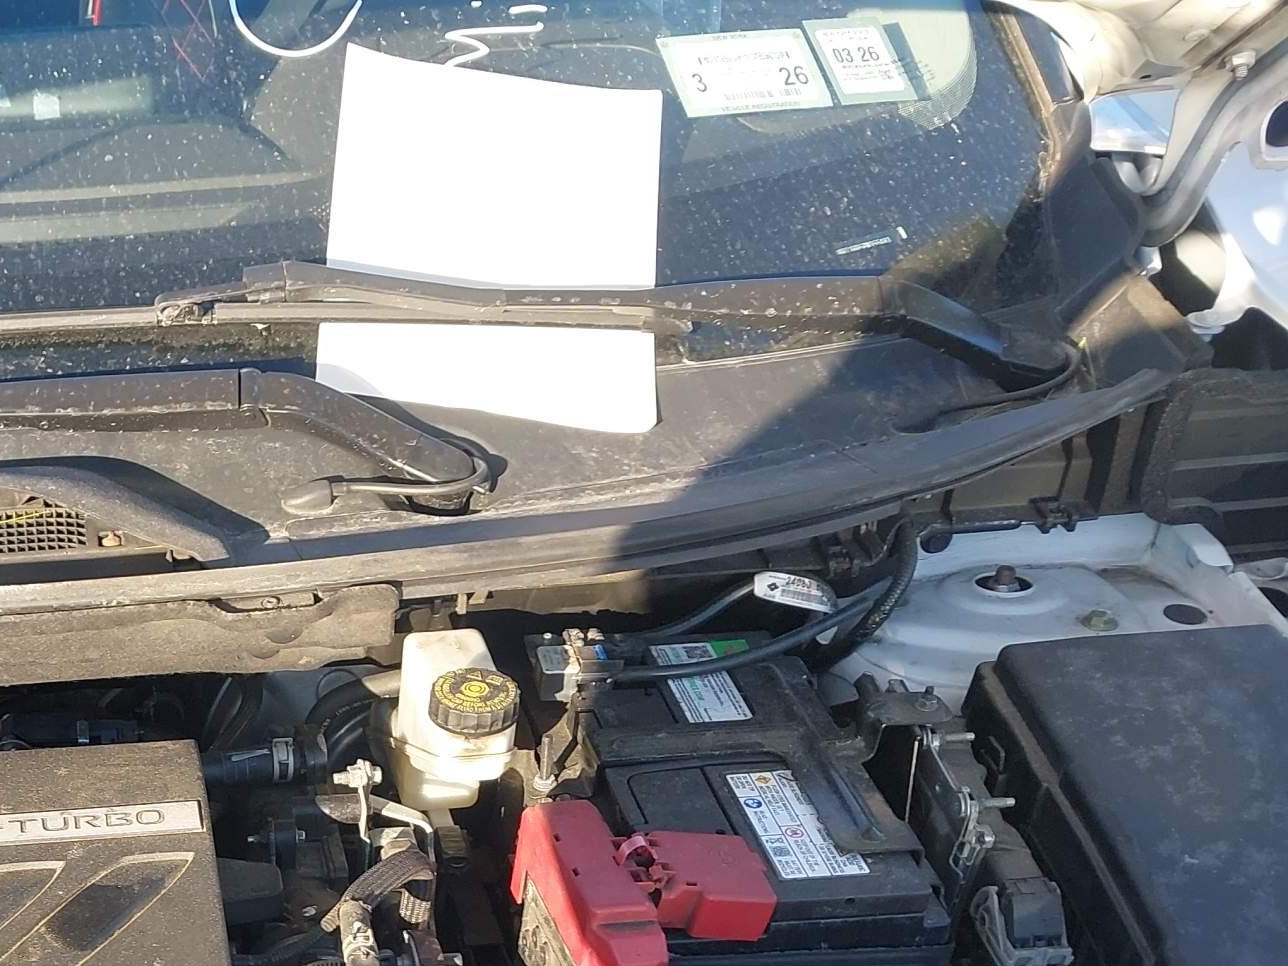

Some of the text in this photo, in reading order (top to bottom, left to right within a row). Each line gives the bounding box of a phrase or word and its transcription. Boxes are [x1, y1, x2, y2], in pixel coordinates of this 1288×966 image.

[831, 45, 881, 64] 03 26
[691, 73, 708, 92] 3
[779, 65, 809, 86] 26
